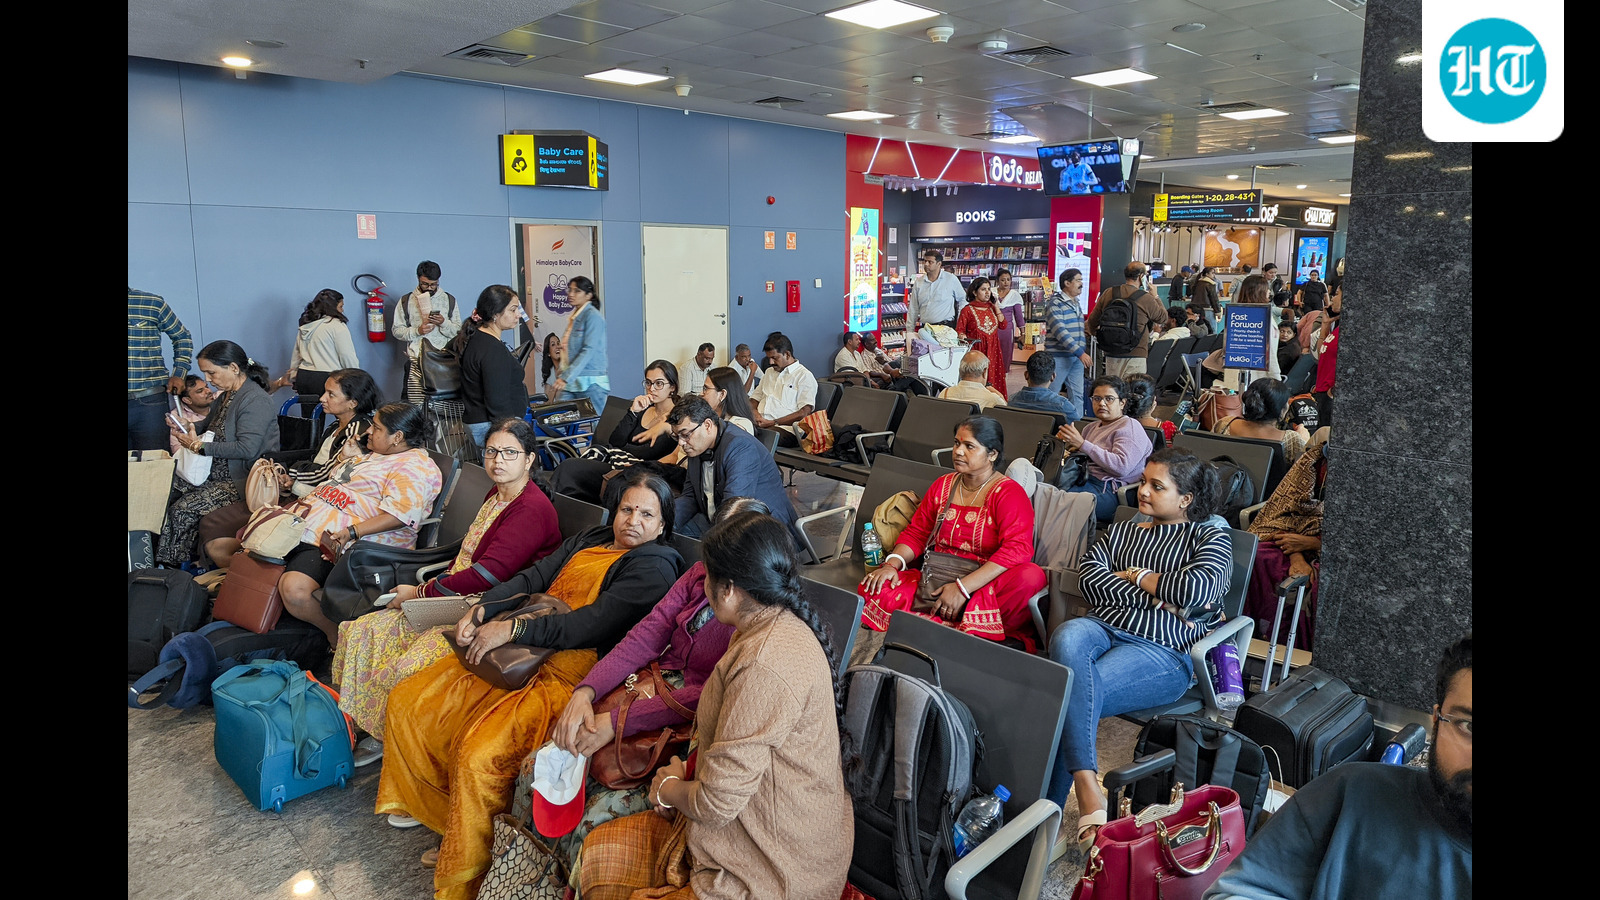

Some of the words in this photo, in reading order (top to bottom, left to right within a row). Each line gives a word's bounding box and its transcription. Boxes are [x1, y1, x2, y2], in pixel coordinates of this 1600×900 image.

[538, 147, 561, 157] Baby
[563, 148, 584, 156] Care
[1205, 194, 1223, 202] 1-20,
[1224, 193, 1248, 201] 28-43
[956, 210, 996, 223] BOOKS
[855, 264, 873, 276] FREE
[552, 293, 568, 301] Happy
[548, 301, 561, 309] Baby
[1230, 320, 1263, 329] Forward
[1229, 355, 1250, 363] IndiGo
